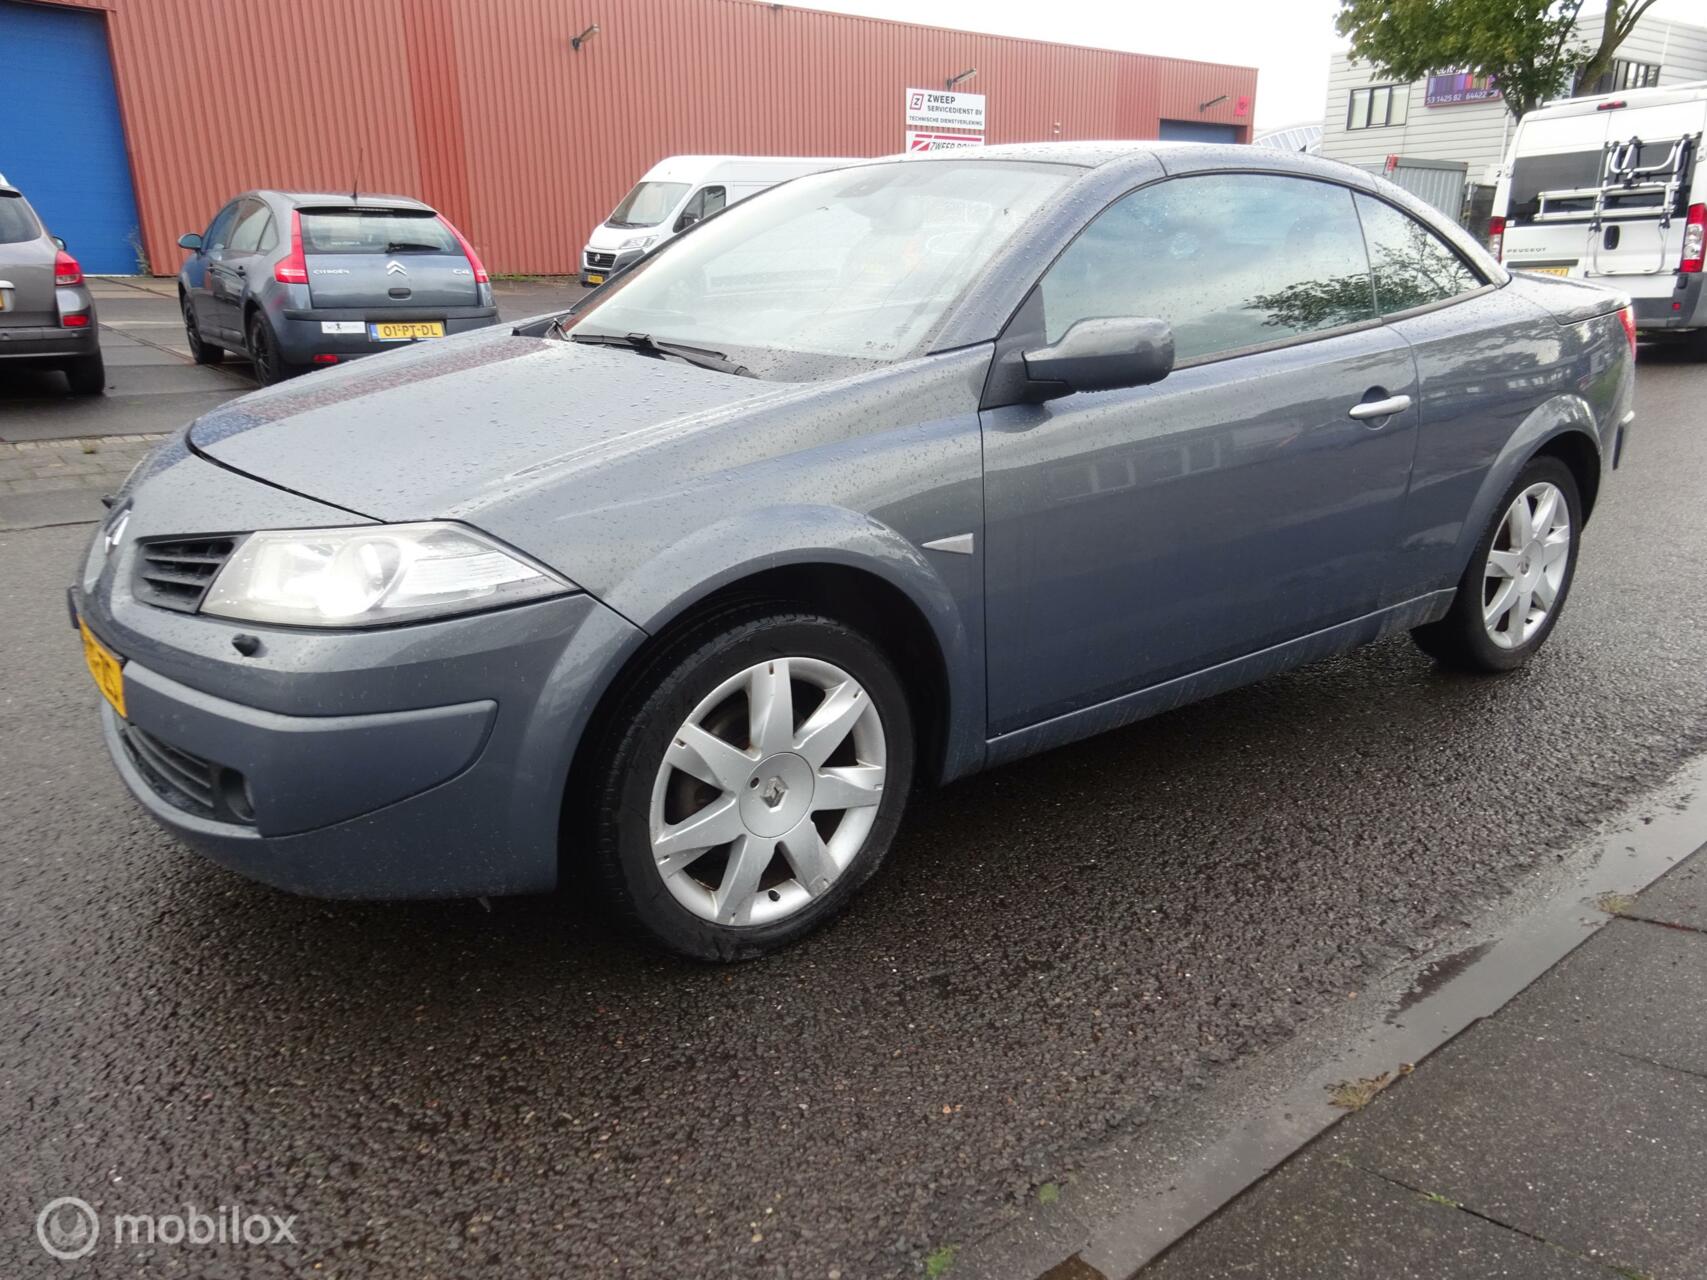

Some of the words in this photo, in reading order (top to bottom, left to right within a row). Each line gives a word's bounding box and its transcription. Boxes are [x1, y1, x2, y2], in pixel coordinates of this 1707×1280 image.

[927, 94, 956, 104] ZWEEP
[927, 105, 974, 115] SERVICEDIENST
[909, 115, 939, 123] TECHNISCHE
